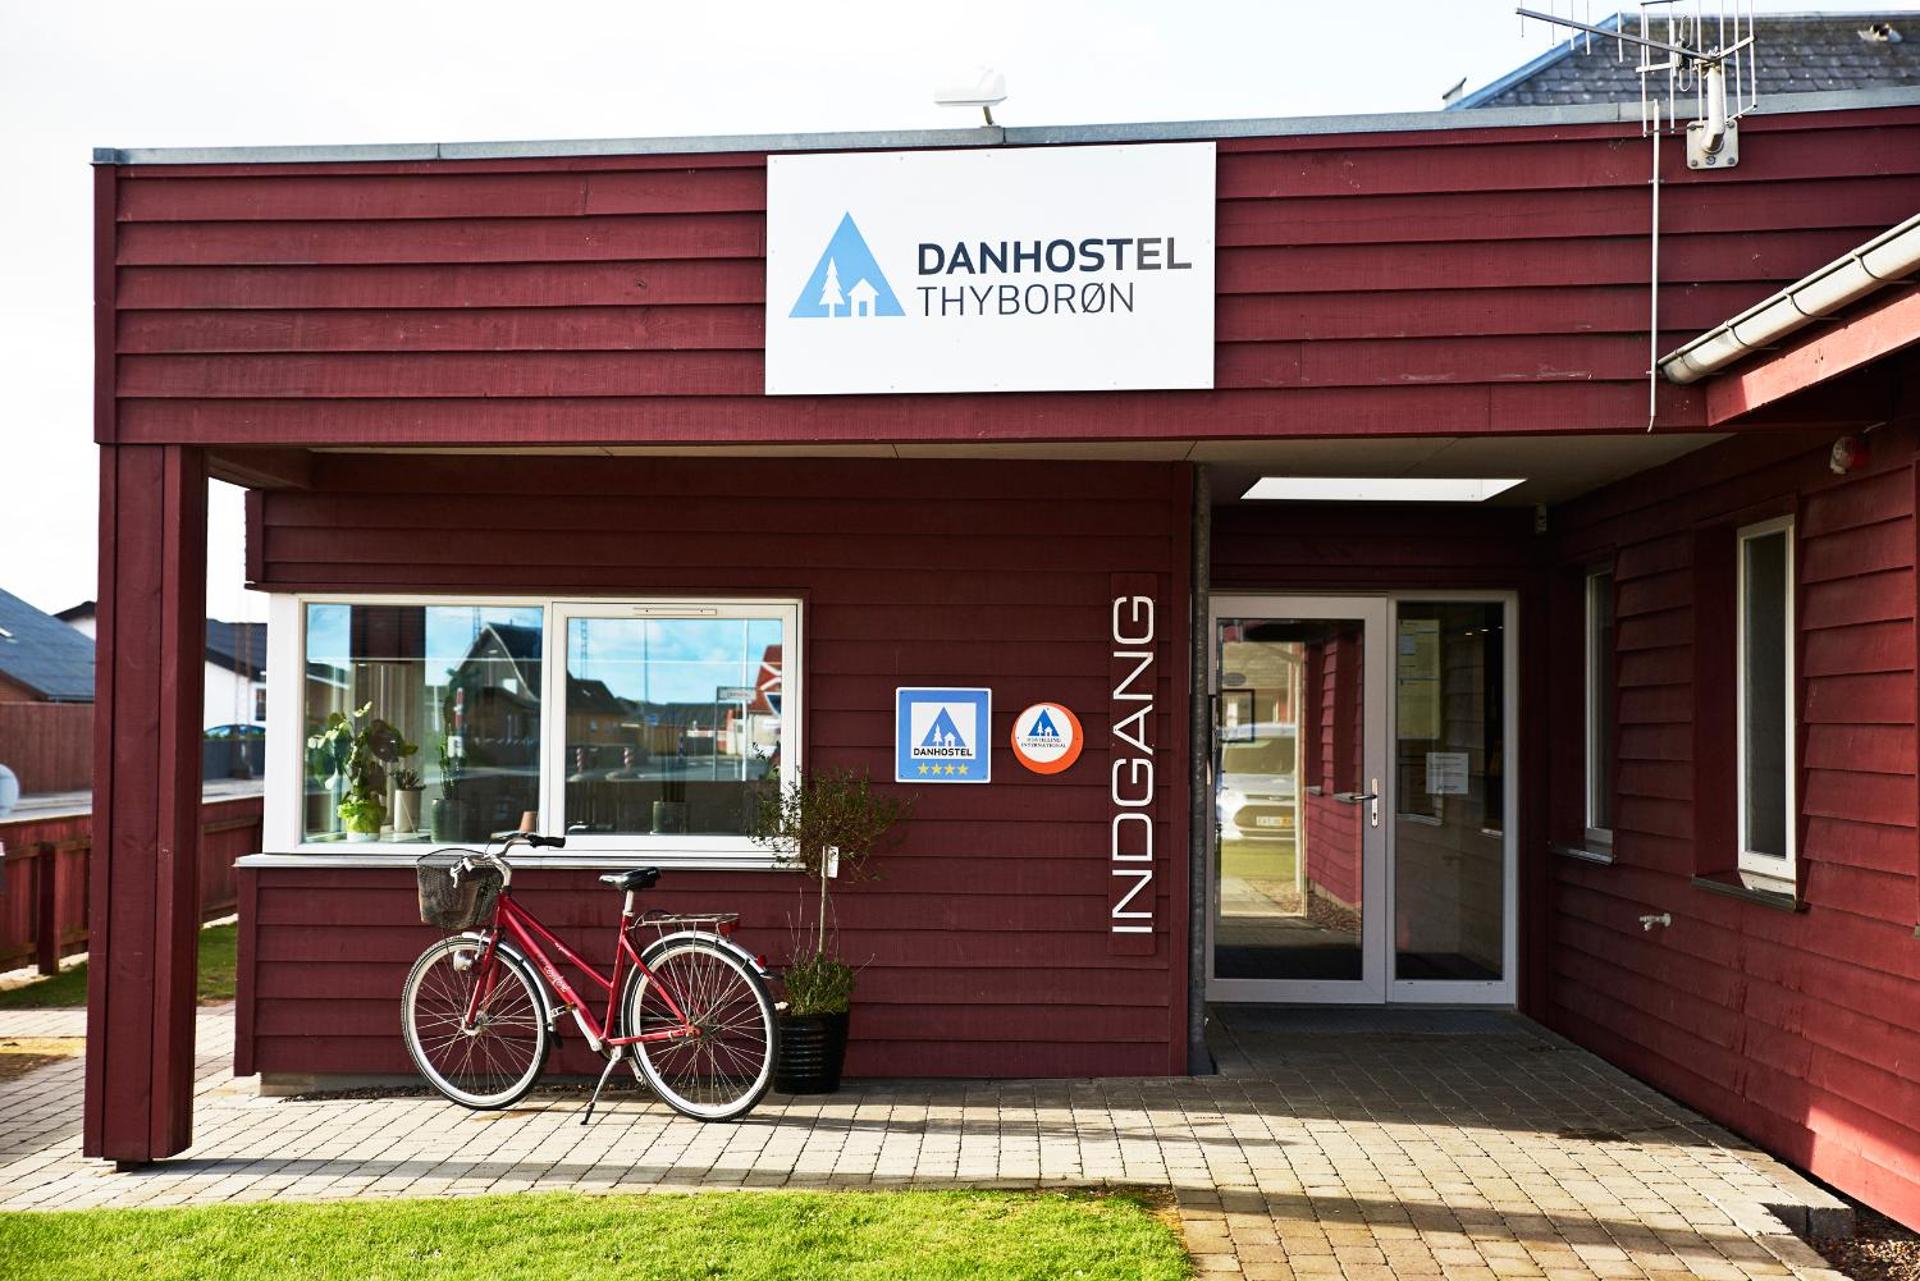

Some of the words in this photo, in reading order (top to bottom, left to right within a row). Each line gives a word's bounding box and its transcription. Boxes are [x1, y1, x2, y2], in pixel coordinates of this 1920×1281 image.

[918, 238, 1192, 274] DANHOSTEL
[917, 282, 1134, 316] THYBORØN
[913, 747, 973, 757] DANHOSTEL
[1111, 595, 1155, 933] INDGANG
